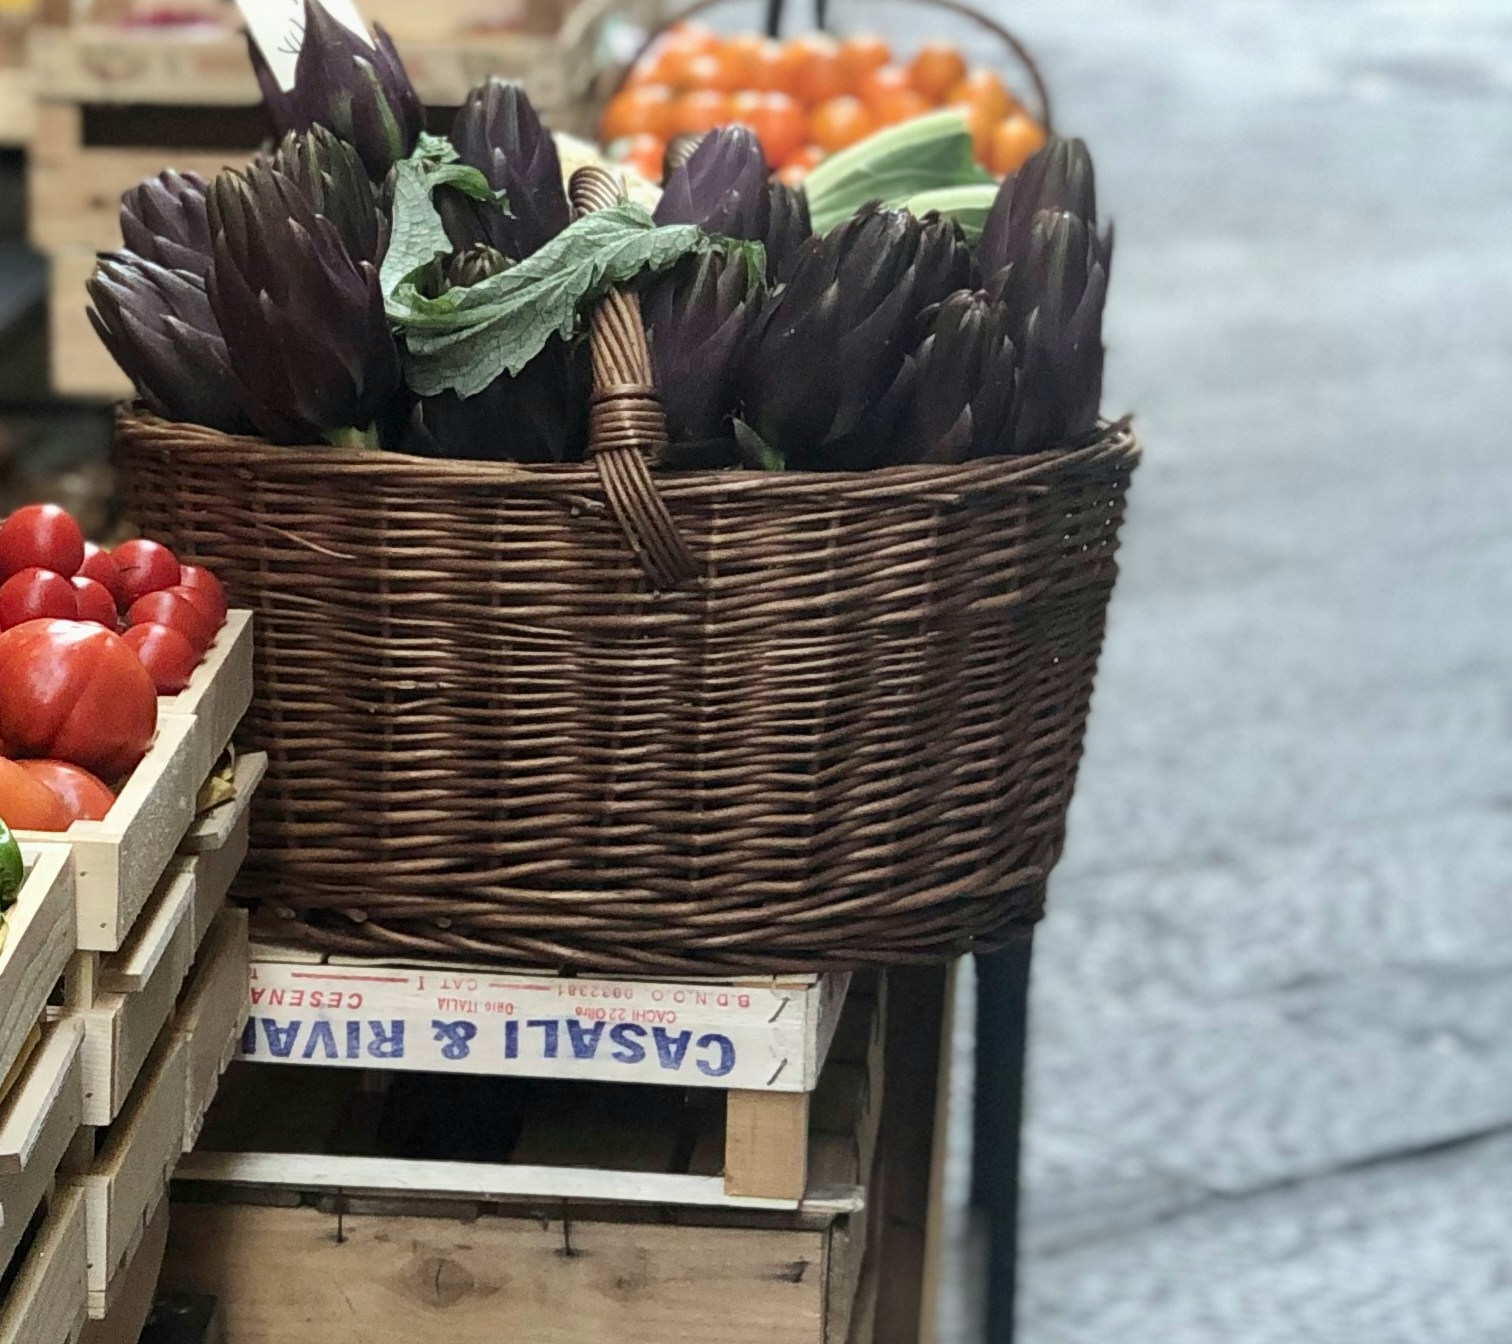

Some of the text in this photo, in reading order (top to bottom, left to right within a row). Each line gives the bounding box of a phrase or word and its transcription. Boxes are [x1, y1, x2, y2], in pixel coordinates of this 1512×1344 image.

[249, 987, 363, 1010] CESENA
[609, 1008, 626, 1022] 22
[631, 1008, 676, 1024] CACHI
[430, 1019, 478, 1061] &
[504, 1019, 736, 1078] CASALI
